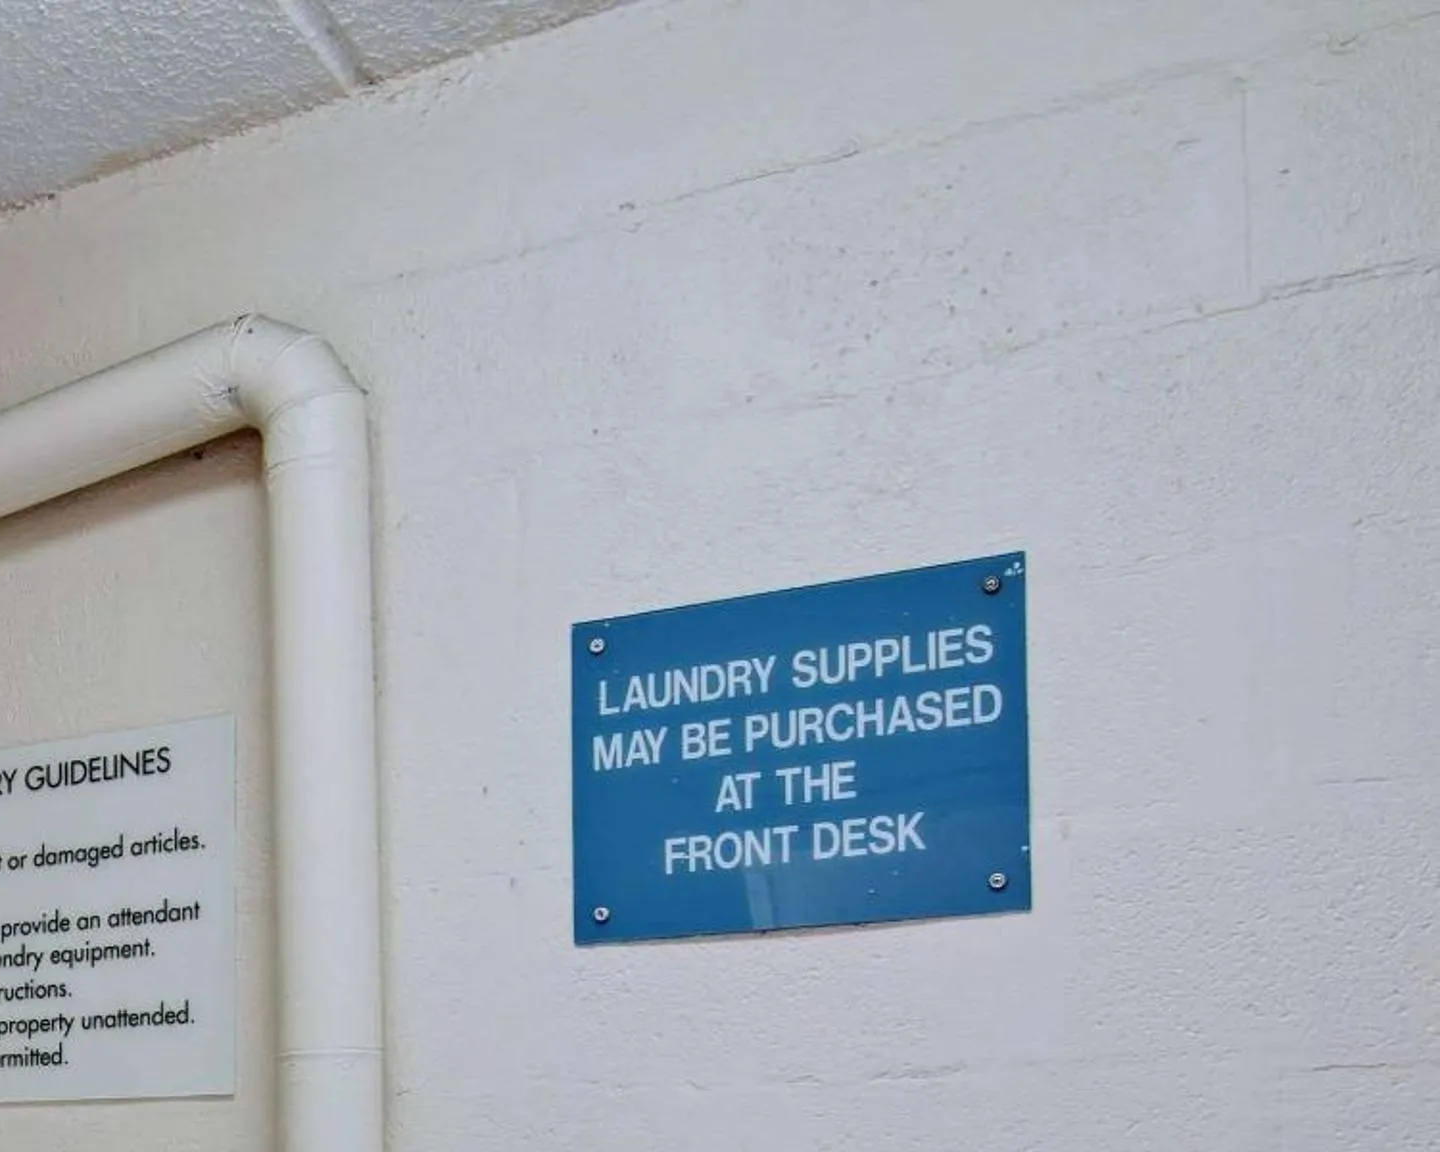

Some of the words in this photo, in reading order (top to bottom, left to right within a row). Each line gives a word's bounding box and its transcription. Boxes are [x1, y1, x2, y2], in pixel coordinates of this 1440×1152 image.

[598, 655, 776, 715] LAUNDRY
[792, 624, 993, 688] SUPPLIES
[593, 727, 668, 771] MAY
[681, 718, 731, 760] BE
[745, 684, 1002, 753] PURCHASED
[25, 747, 171, 791] GUIDELINES
[715, 772, 761, 812] AT
[776, 761, 856, 805] THE
[8, 852, 27, 870] or
[33, 835, 123, 868] damaged
[130, 829, 206, 855] articles.
[664, 825, 798, 874] FRONT
[813, 812, 925, 860] DESK
[0, 911, 70, 942] provide
[76, 912, 101, 930] an
[107, 900, 200, 927] attendant
[49, 938, 155, 967] equipment.
[81, 1001, 194, 1029] unattended.
